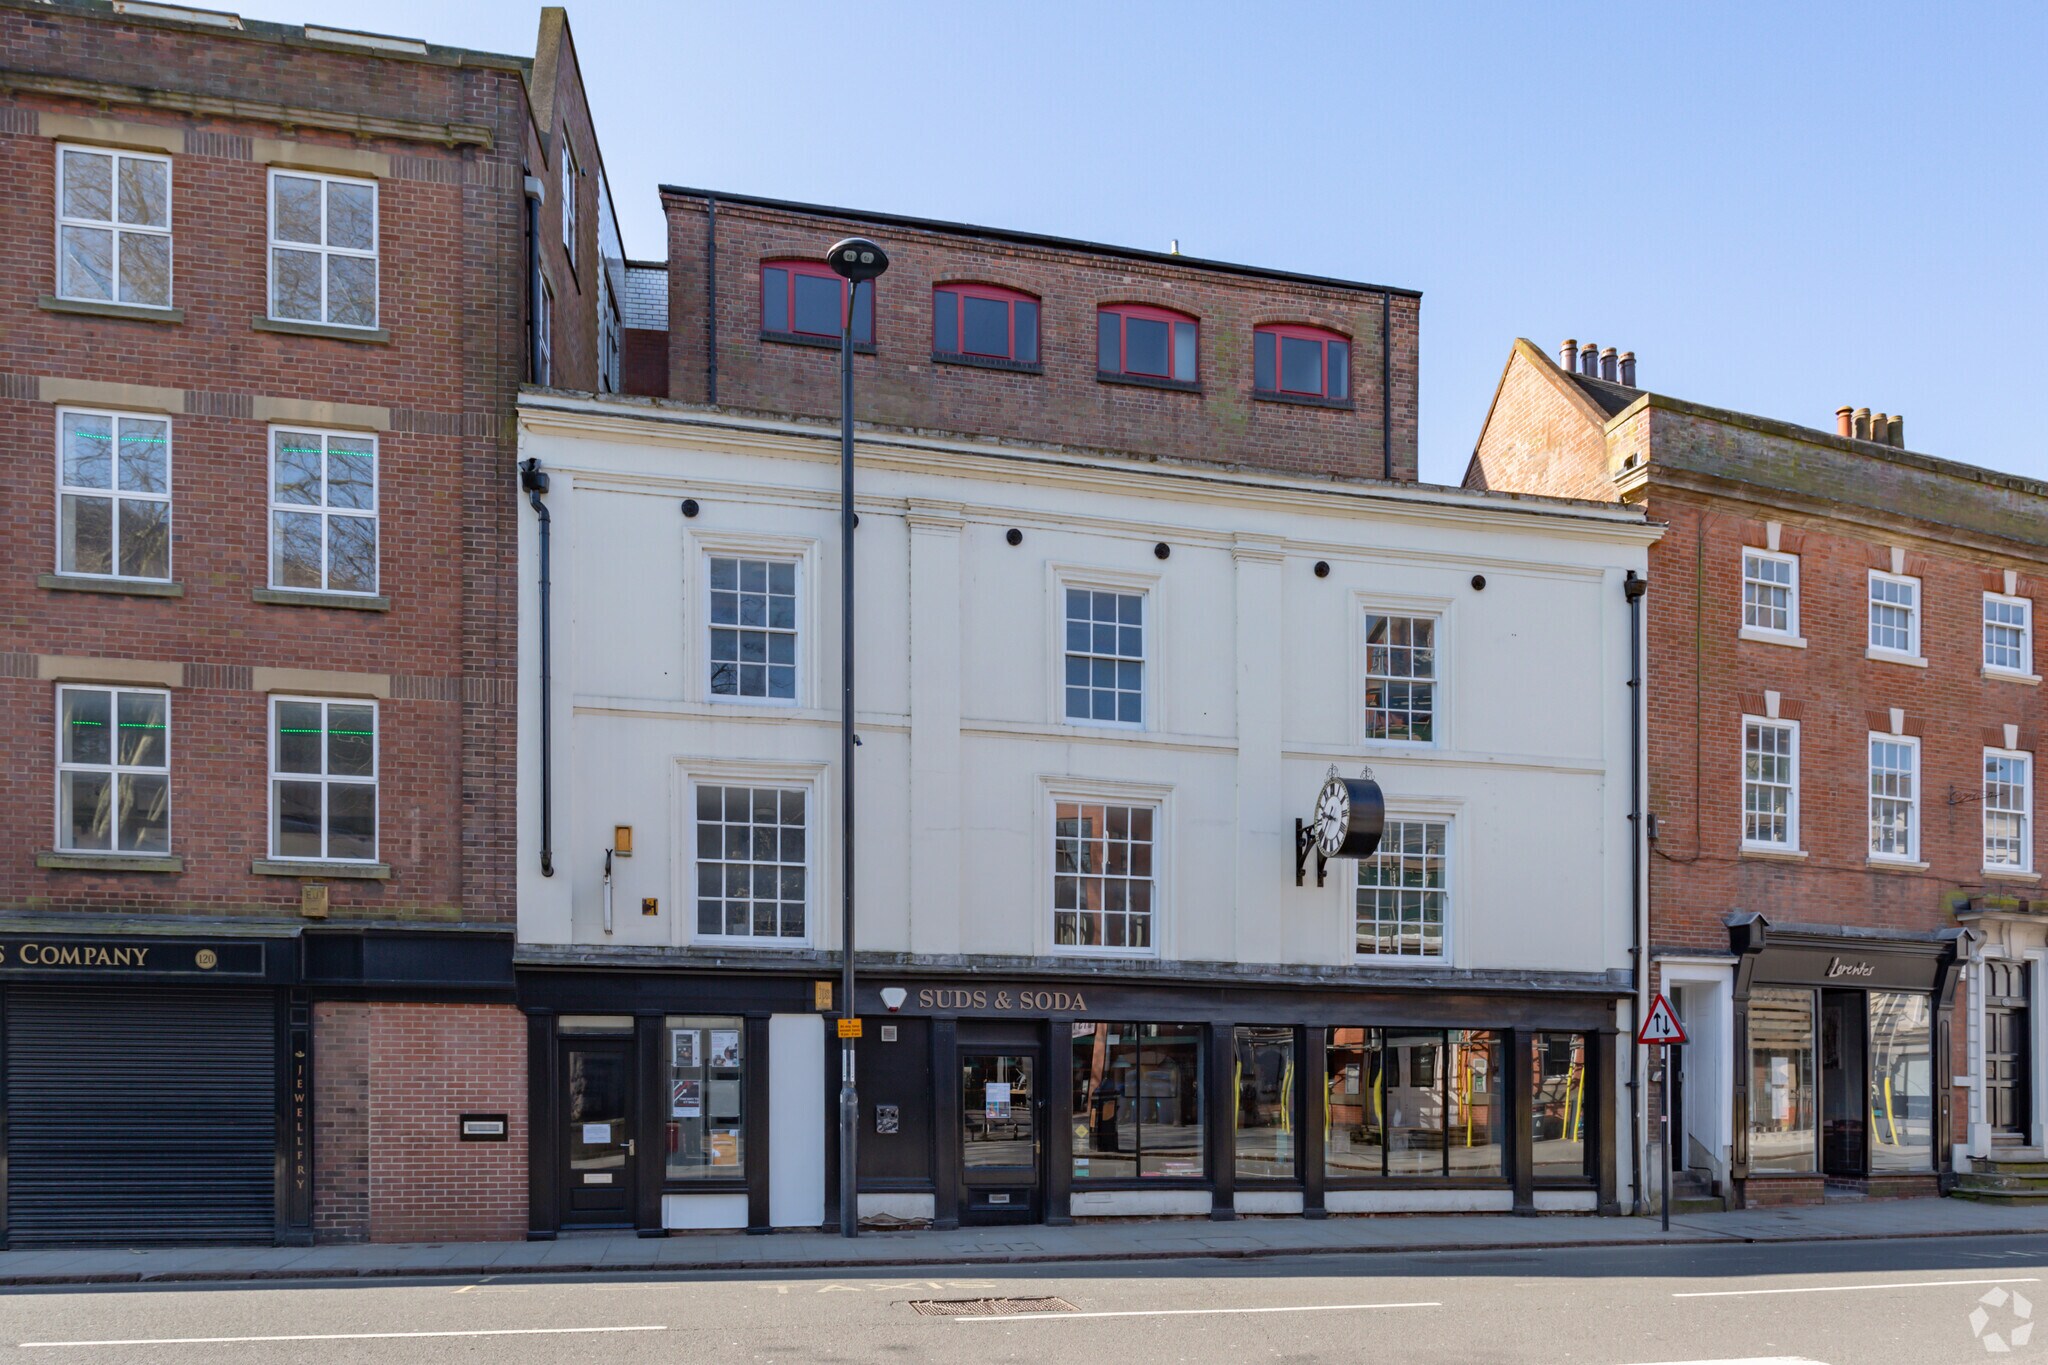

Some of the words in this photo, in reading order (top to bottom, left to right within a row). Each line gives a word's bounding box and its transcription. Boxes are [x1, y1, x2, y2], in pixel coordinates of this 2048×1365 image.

[19, 943, 149, 966] COMPANY
[199, 954, 215, 964] 120
[919, 988, 987, 1009] SUDS
[994, 990, 1012, 1010] &
[1020, 991, 1088, 1011] SODA
[757, 1281, 996, 1295] TAXIS
